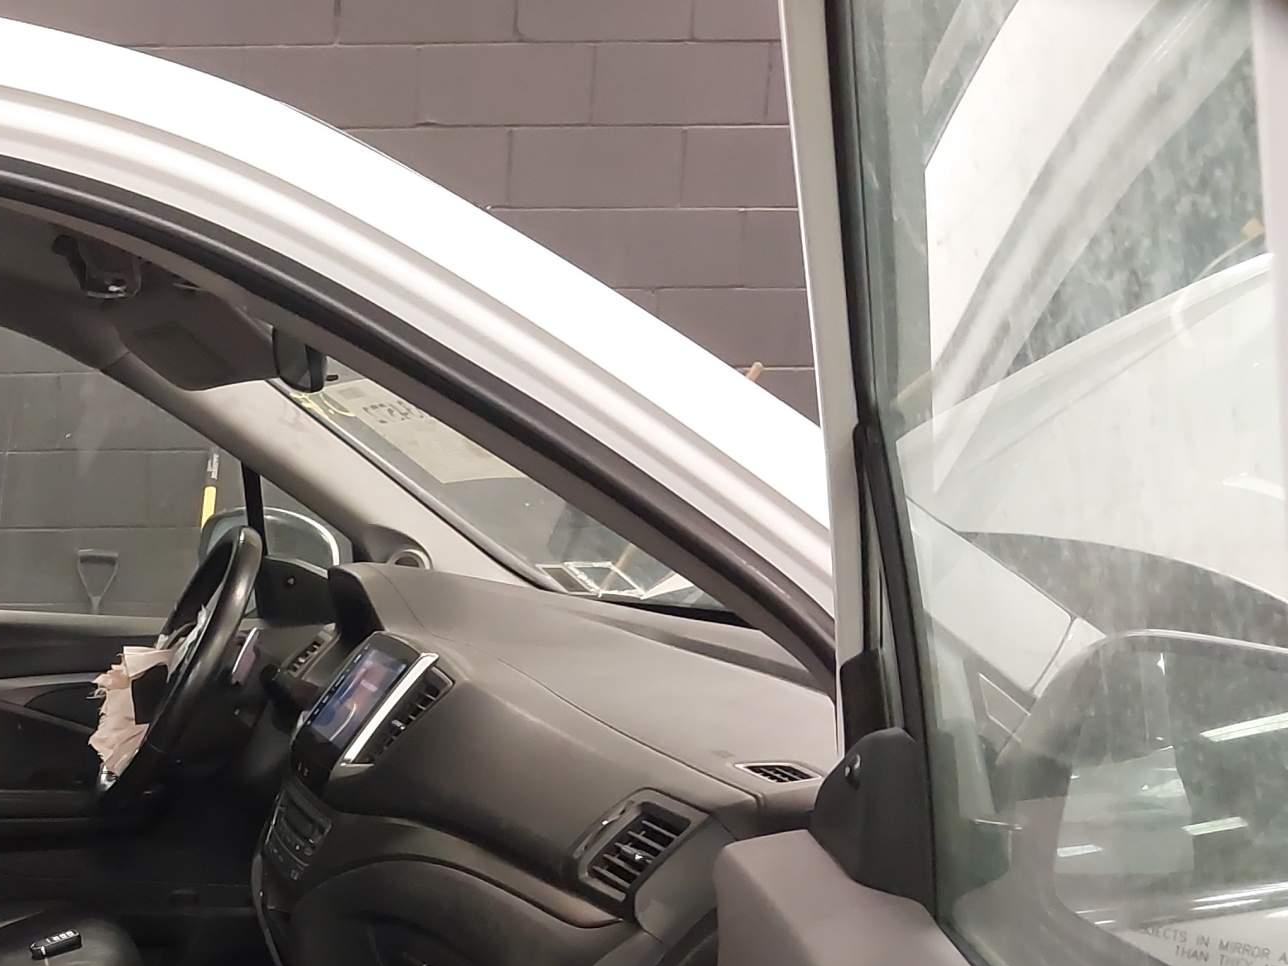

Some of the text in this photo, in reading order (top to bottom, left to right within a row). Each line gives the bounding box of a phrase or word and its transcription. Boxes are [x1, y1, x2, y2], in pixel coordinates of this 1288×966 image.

[1175, 944, 1209, 963] THAN
[1196, 935, 1210, 948] IN
[1219, 939, 1271, 960] MIRROR
